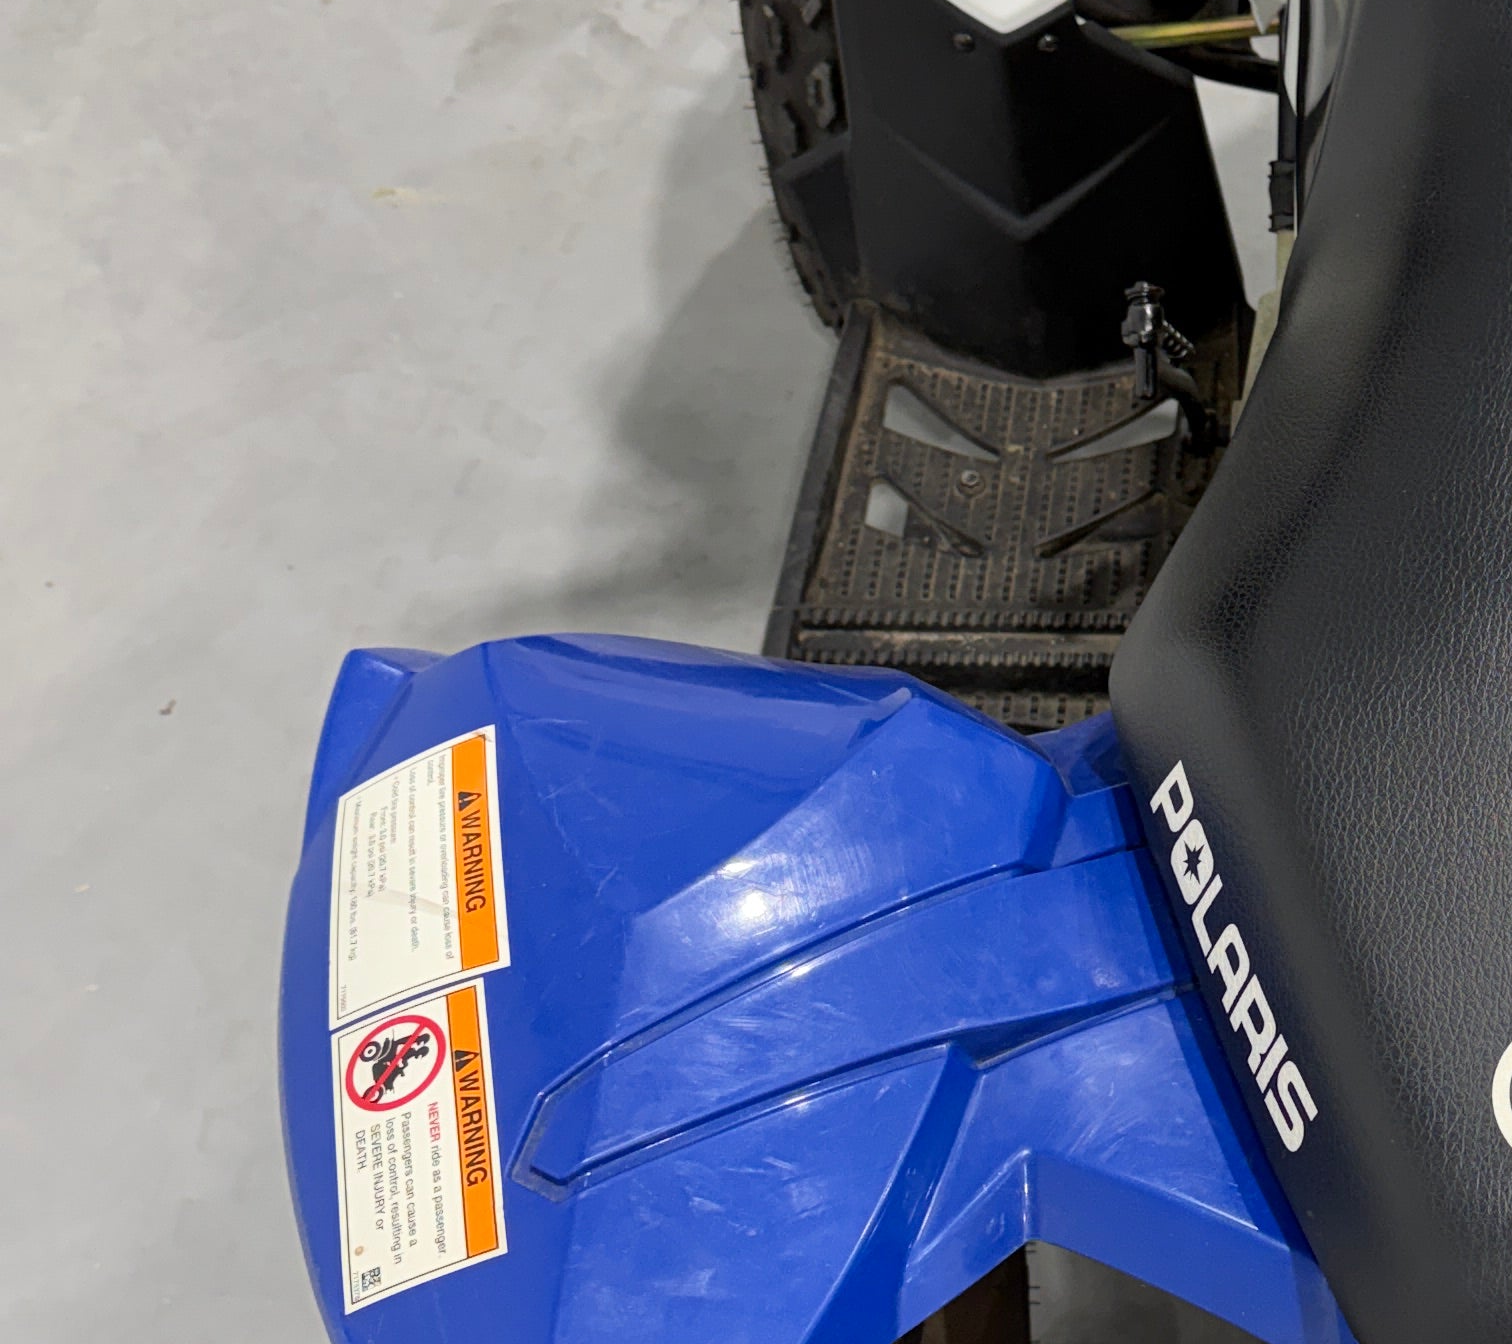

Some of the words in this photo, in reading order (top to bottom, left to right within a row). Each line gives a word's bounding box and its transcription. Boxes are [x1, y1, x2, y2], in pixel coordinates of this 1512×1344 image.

[461, 809, 486, 913] WARNING
[1150, 760, 1319, 1152] POLARIS
[386, 1118, 398, 1141] loss
[427, 1101, 441, 1143] NEVER
[458, 1070, 487, 1187] WARNING
[355, 1129, 368, 1173] DEATH.
[370, 1124, 383, 1168] SEVERE
[387, 1143, 399, 1154] of
[400, 1112, 415, 1176] Passengers
[431, 1145, 444, 1167] ride
[372, 1172, 385, 1215] INJURY
[387, 1157, 401, 1199] control,
[405, 1178, 415, 1200] can
[433, 1170, 443, 1183] as
[375, 1219, 385, 1231] or
[389, 1202, 403, 1251] resulting
[406, 1202, 417, 1237] cause
[432, 1196, 448, 1258] passenger.
[393, 1253, 403, 1264] in
[409, 1239, 418, 1247] a
